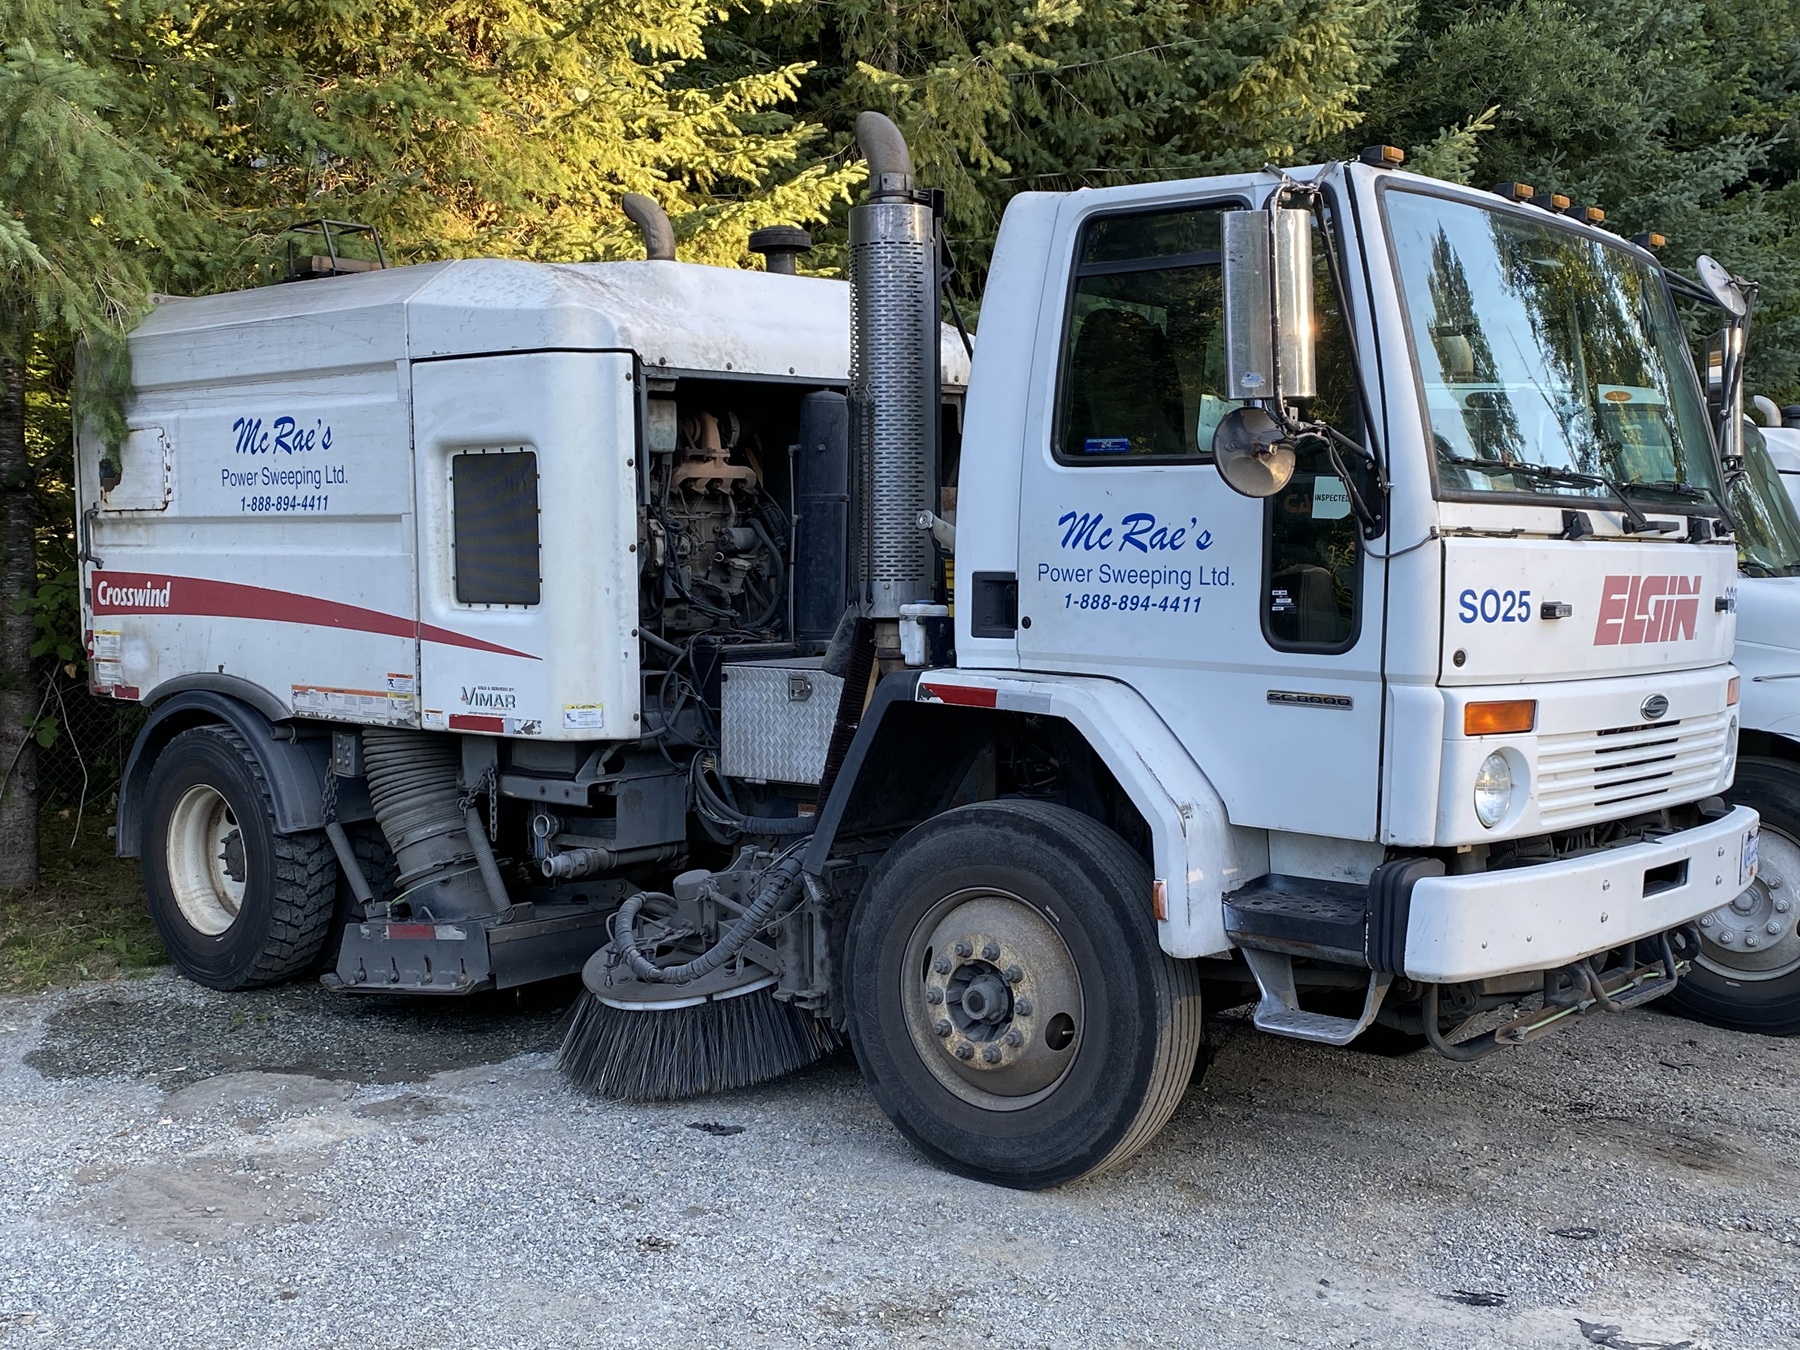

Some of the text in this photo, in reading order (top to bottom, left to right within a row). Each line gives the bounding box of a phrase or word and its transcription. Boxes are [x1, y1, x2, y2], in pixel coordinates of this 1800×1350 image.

[221, 464, 349, 490] Power Sweeping Ltd.
[240, 494, 329, 512] 1-888-894-4411
[1038, 563, 1235, 591] Power Sweeping Ltd.
[97, 580, 171, 608] Crosswind
[1064, 593, 1202, 614] 1-888-894-4411
[1593, 575, 1702, 646] ELGIN
[461, 686, 516, 709] VIMAR
